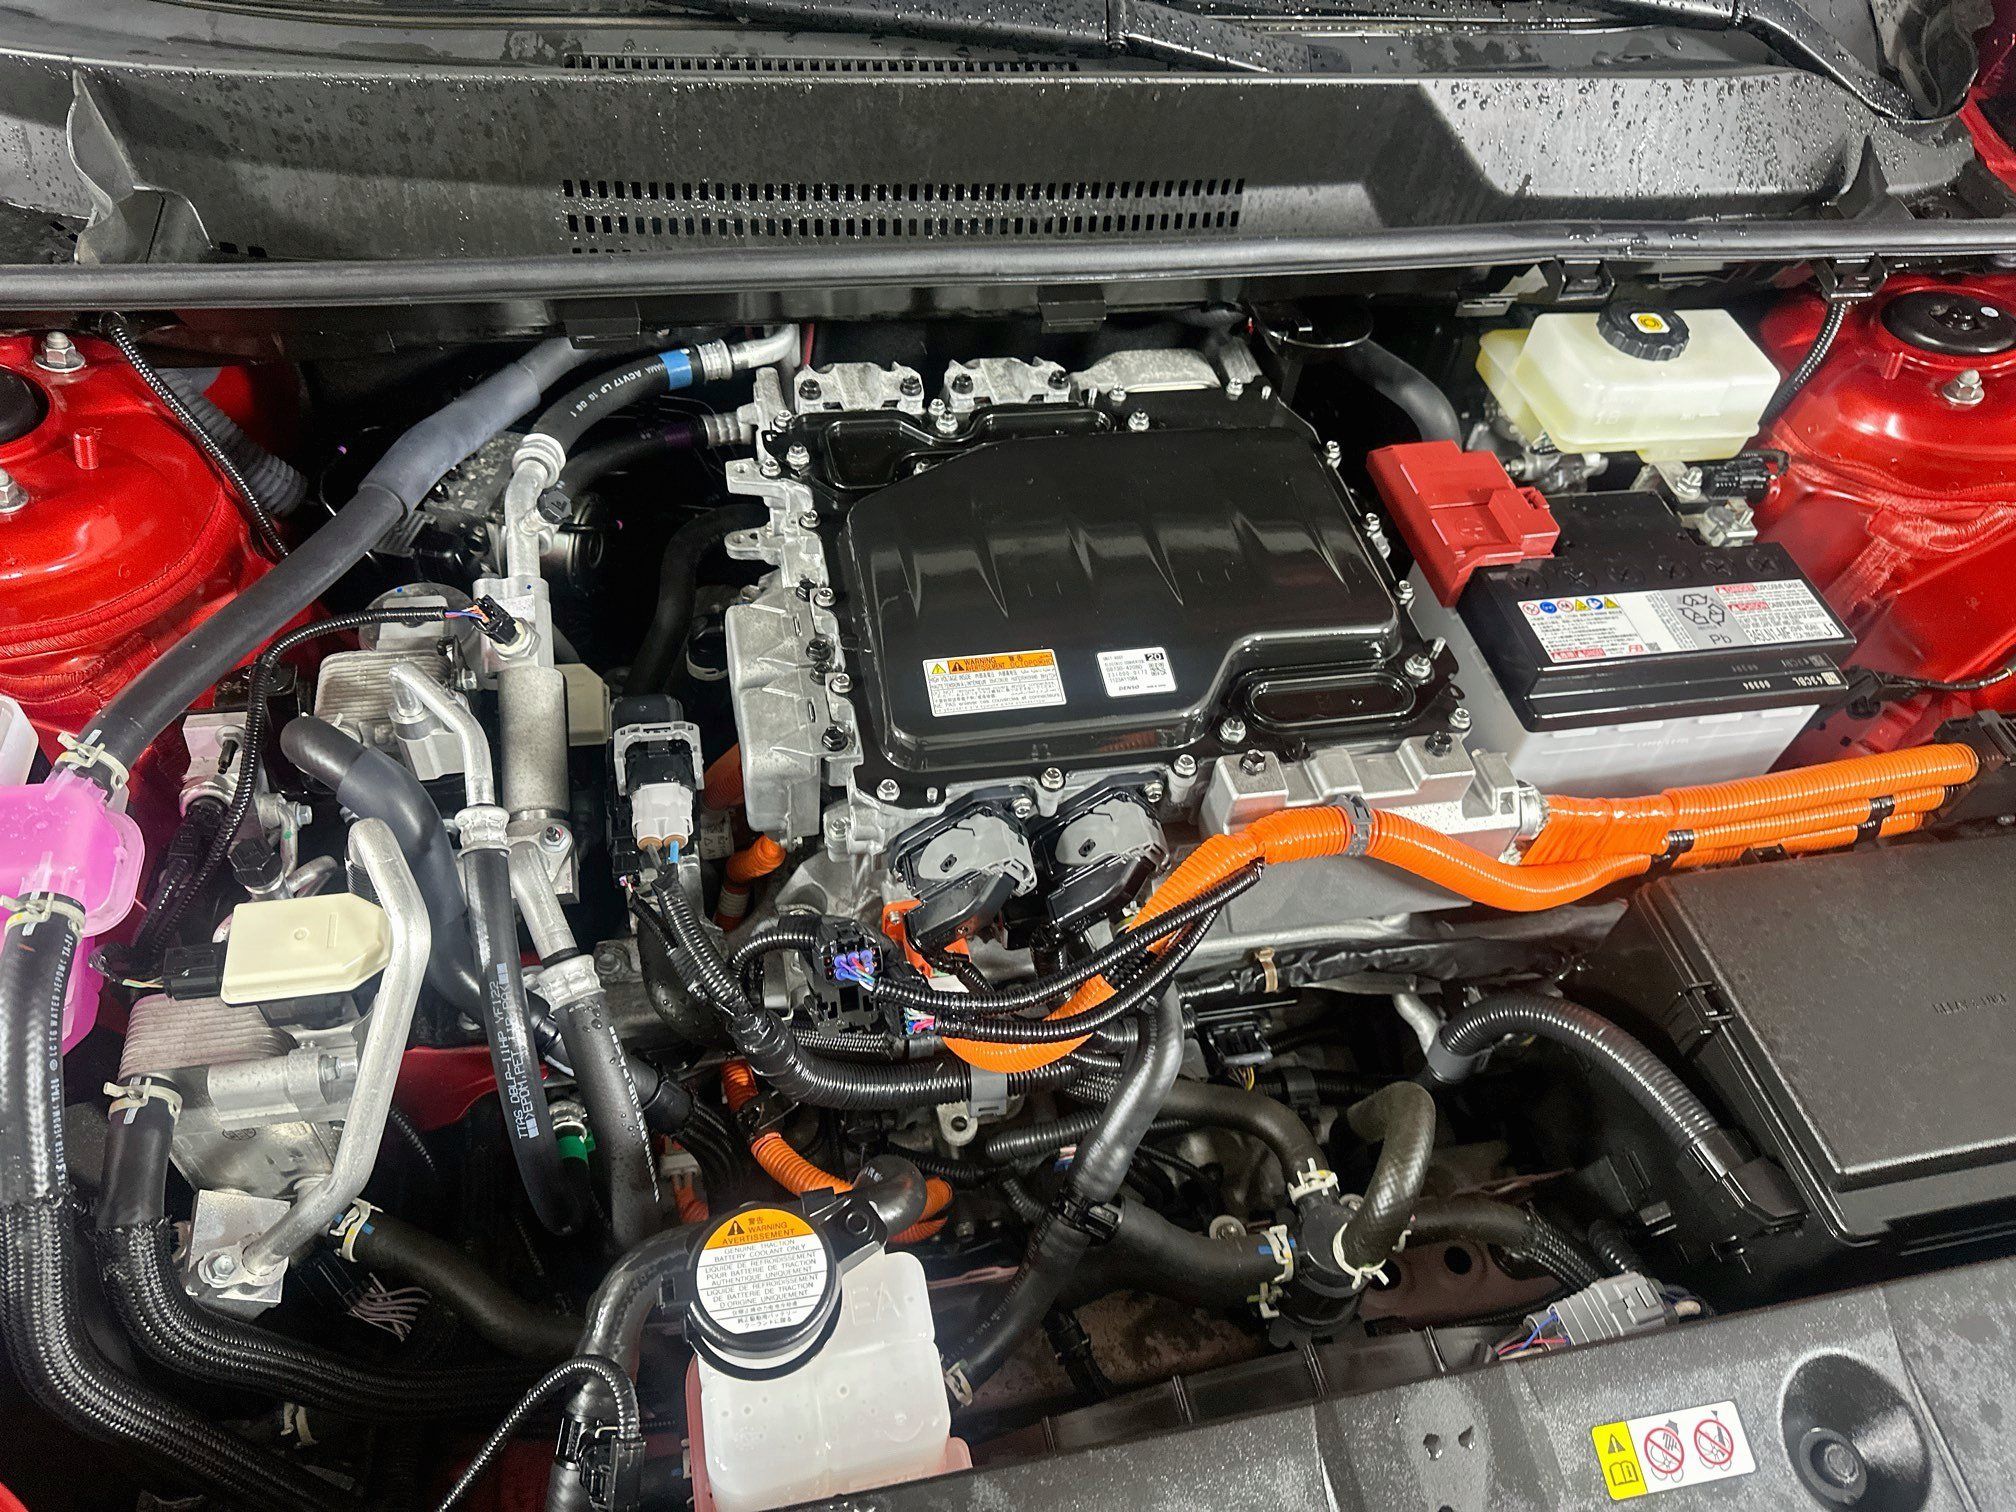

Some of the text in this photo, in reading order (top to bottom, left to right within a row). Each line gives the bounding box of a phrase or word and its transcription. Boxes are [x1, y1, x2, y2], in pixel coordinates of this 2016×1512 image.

[613, 369, 642, 387] ACV17
[600, 384, 613, 394] LP
[1709, 634, 1732, 645] Pb
[964, 656, 997, 667] WARNING
[1145, 652, 1162, 661] 20
[965, 662, 1005, 673] AVERTISSEMENT
[50, 997, 61, 1028] WATER
[489, 980, 529, 1140] TTAS DBLP-11HP YF122
[722, 1228, 795, 1246] AVERTISSEMENT
[748, 1222, 788, 1234] WARNING
[714, 1243, 806, 1263] BATTERY COOLANT ONLY
[724, 1239, 795, 1255] GENUINE TRACTION
[705, 1264, 733, 1274] LIQUIDE
[750, 1252, 817, 1267] REFROIDISSEMENT
[706, 1258, 817, 1281] POUR BATTERIE DE TRACTION
[706, 1287, 734, 1297] LIQUIDE
[752, 1274, 819, 1289] REFROIDISSEMENT
[711, 1266, 813, 1287] AUTHENTIQUE UNIQUEMENT
[712, 1281, 814, 1303] DE BATTERIE DE TRACTION
[760, 1290, 808, 1302] UNIQUEMENT
